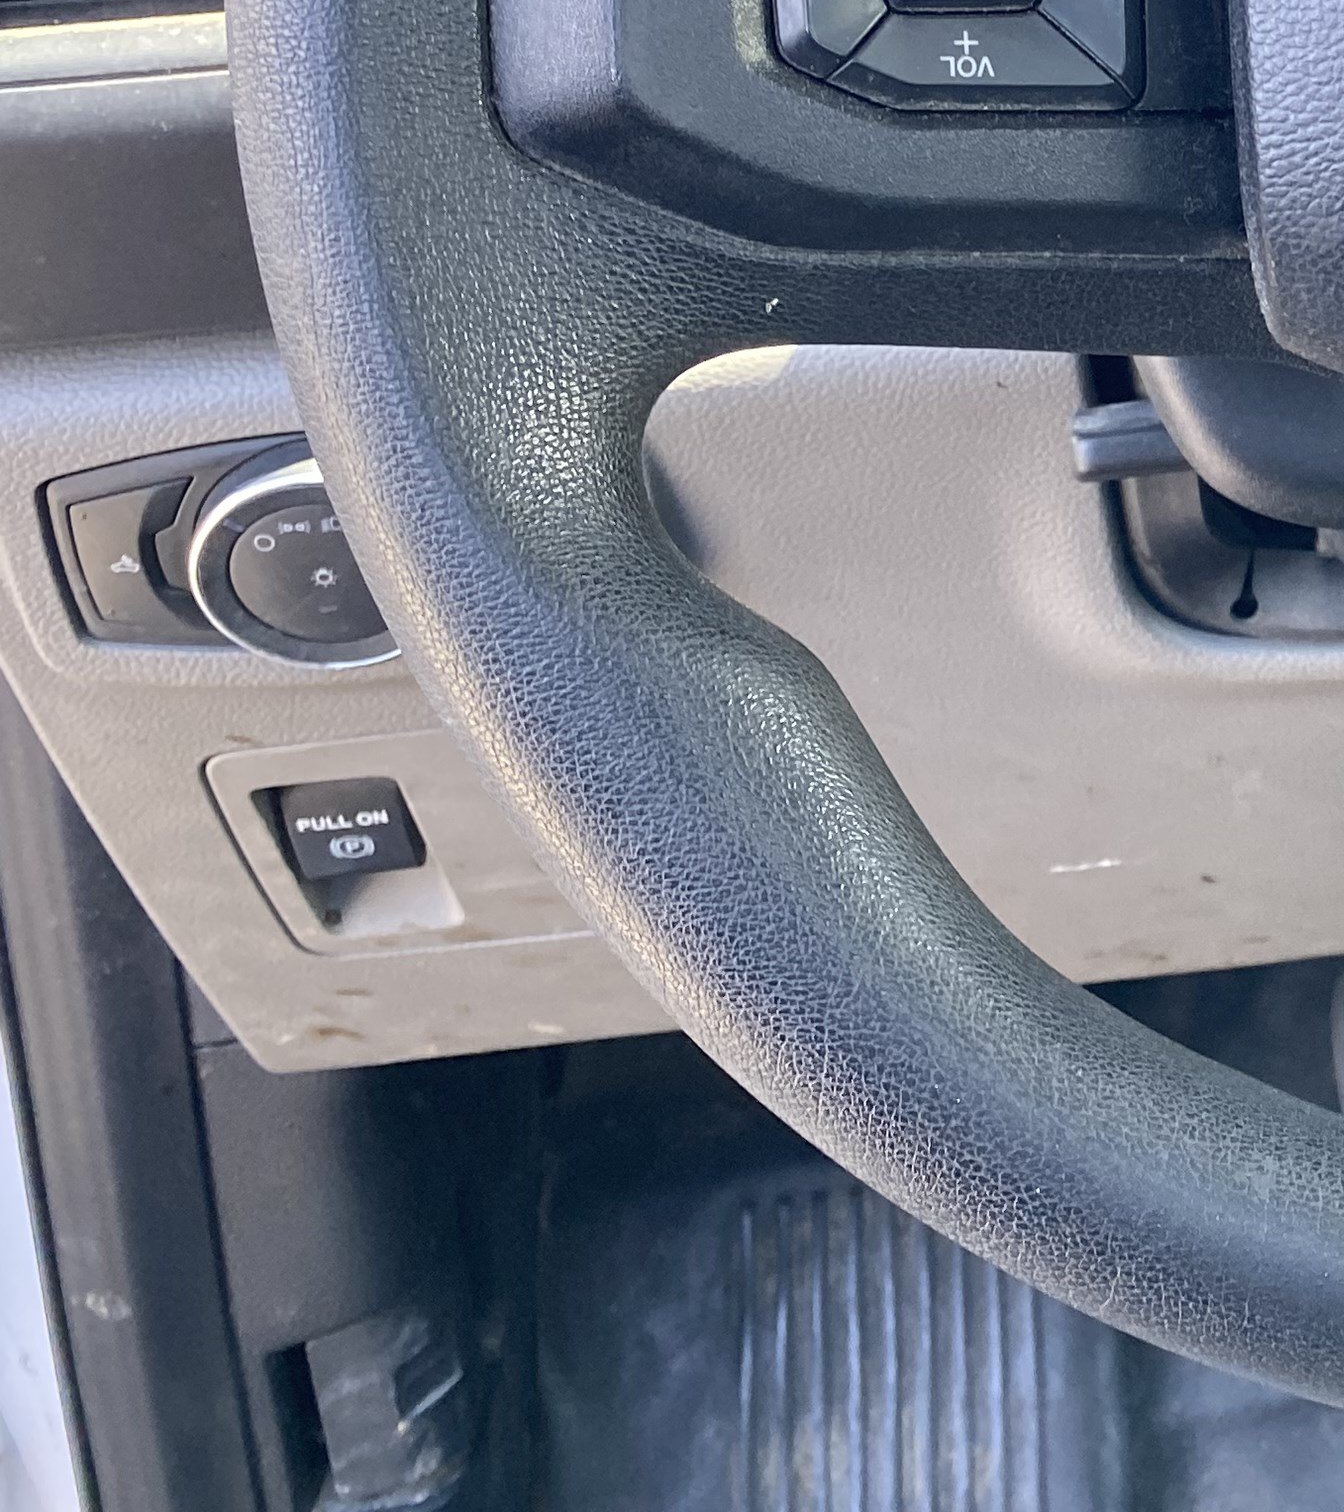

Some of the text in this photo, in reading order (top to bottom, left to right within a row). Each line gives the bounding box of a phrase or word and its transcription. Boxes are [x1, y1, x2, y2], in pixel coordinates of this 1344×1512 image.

[939, 55, 995, 78] VOL
[296, 808, 389, 833] PULL ON
